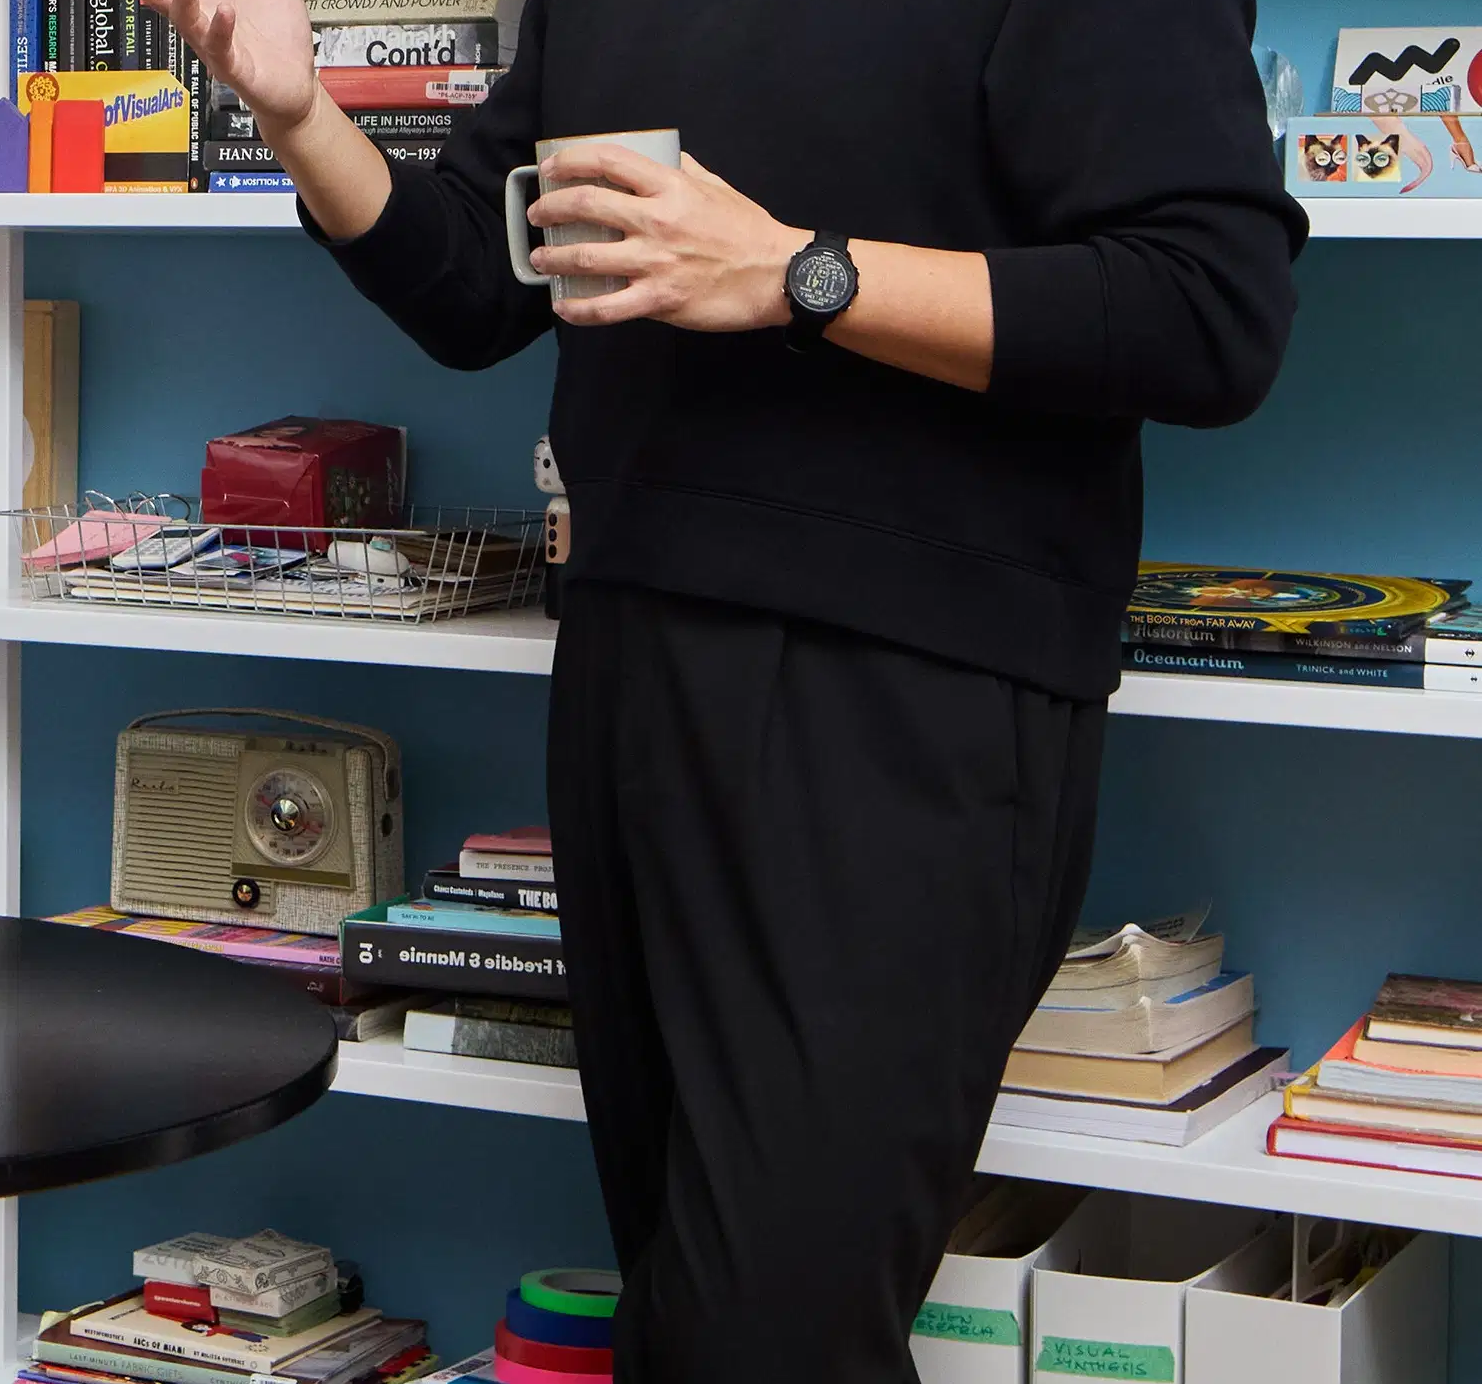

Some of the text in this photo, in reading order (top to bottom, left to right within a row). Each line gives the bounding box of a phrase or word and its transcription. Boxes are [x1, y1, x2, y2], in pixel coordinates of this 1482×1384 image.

[48, 14, 57, 59] RESEARCH
[126, 16, 135, 56] RETAIL
[366, 40, 456, 67] Cont'd
[191, 59, 199, 161] THE FALL OF PUBLIC MAN
[354, 115, 452, 127] LIFE IN HUTONGS
[399, 127, 426, 135] Alleyways
[433, 127, 452, 135] Beijing
[219, 148, 253, 160] HAN
[1130, 615, 1255, 629] THE BOOK FROM FAR AWAY
[1133, 624, 1215, 641] Historium
[1296, 638, 1351, 650] WILKINSON
[1372, 644, 1412, 653] NELSON
[1134, 648, 1244, 670] Oceanarium
[1296, 664, 1388, 678] TRINICK and WHITE
[493, 863, 529, 871] PRESENCE
[518, 888, 541, 908] THE
[1054, 1343, 1130, 1359] VISUAL
[121, 1357, 154, 1374] FABRIC
[156, 1366, 183, 1380] GIFTS
[1053, 1358, 1148, 1377] SYNTHESIS
